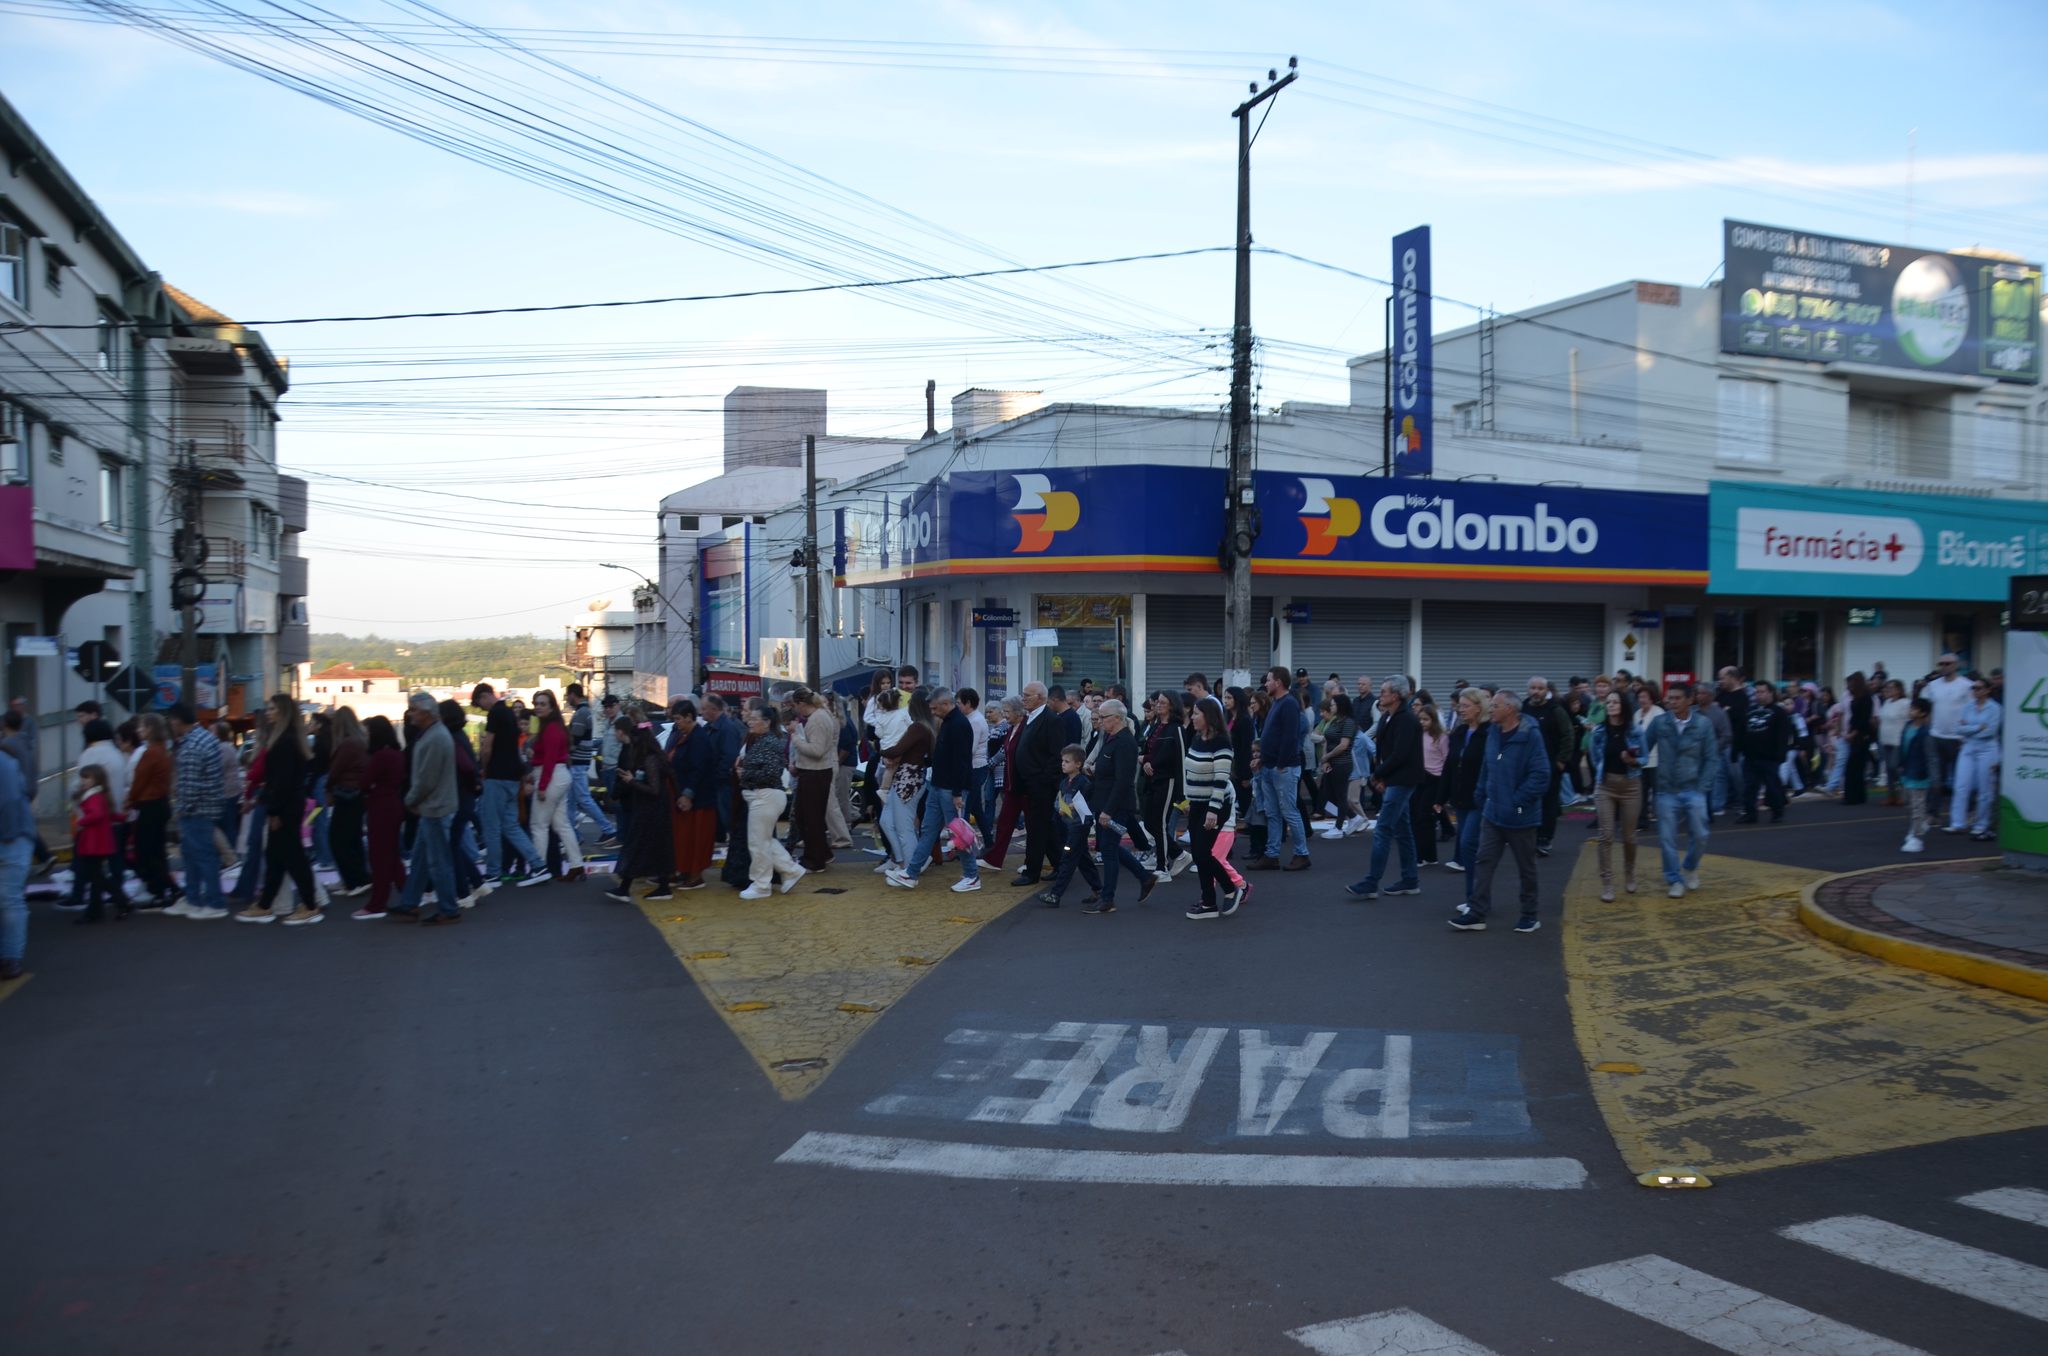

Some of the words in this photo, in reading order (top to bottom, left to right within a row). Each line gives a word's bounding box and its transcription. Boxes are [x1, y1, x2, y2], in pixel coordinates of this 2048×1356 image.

[1731, 226, 1767, 250] COMO
[1399, 247, 1418, 410] Colombo
[1406, 493, 1427, 508] lojas
[1370, 494, 1599, 553] Colombo
[982, 613, 1012, 621] Colombo
[710, 679, 736, 692] BARATO
[738, 680, 760, 693] MANIA
[966, 1021, 1413, 1139] PARE
